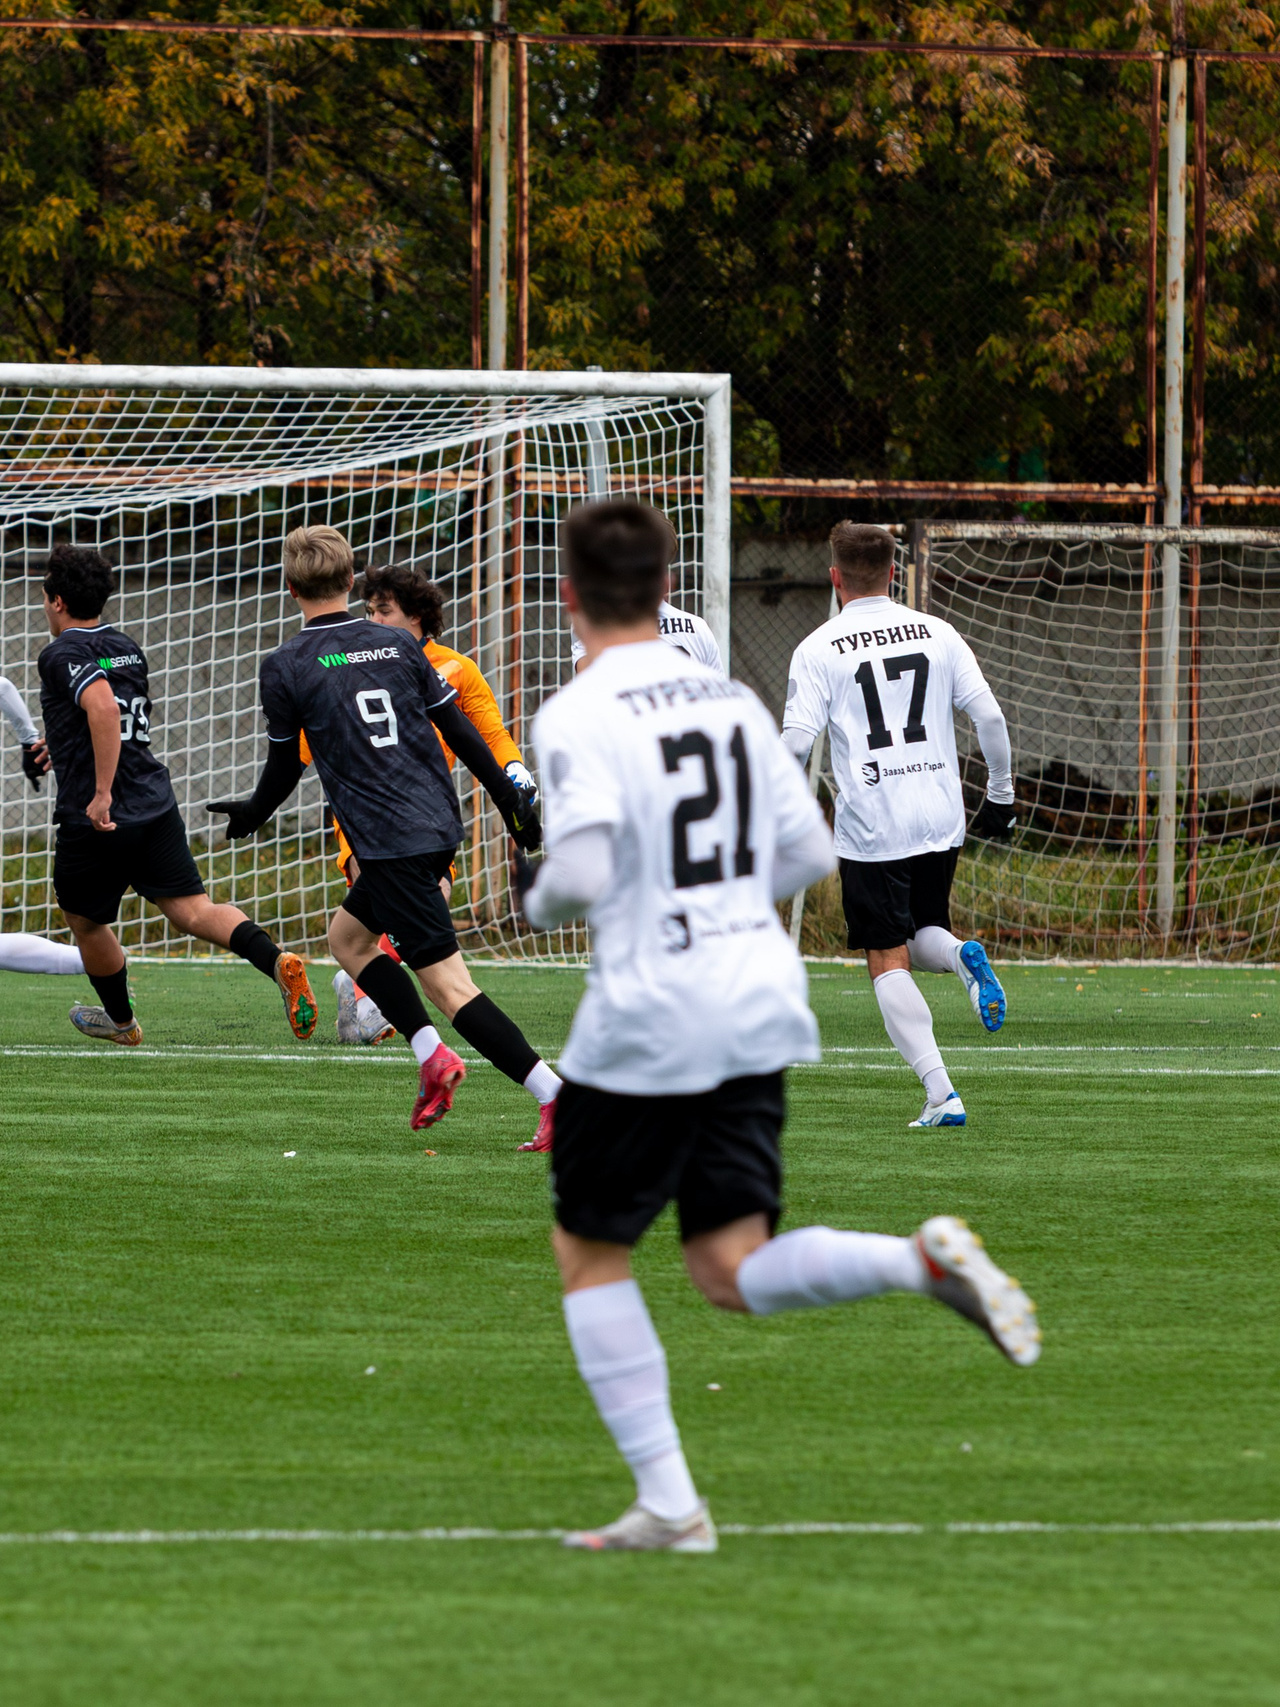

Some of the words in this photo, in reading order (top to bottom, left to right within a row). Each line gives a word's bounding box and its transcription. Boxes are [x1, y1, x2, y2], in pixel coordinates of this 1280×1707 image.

[317, 647, 400, 668] VINSERVICE
[831, 624, 932, 655] ТУРБИНА
[355, 688, 399, 749] 9
[854, 652, 930, 751] 17
[906, 763, 922, 774] АКЗ
[657, 725, 754, 889] 21
